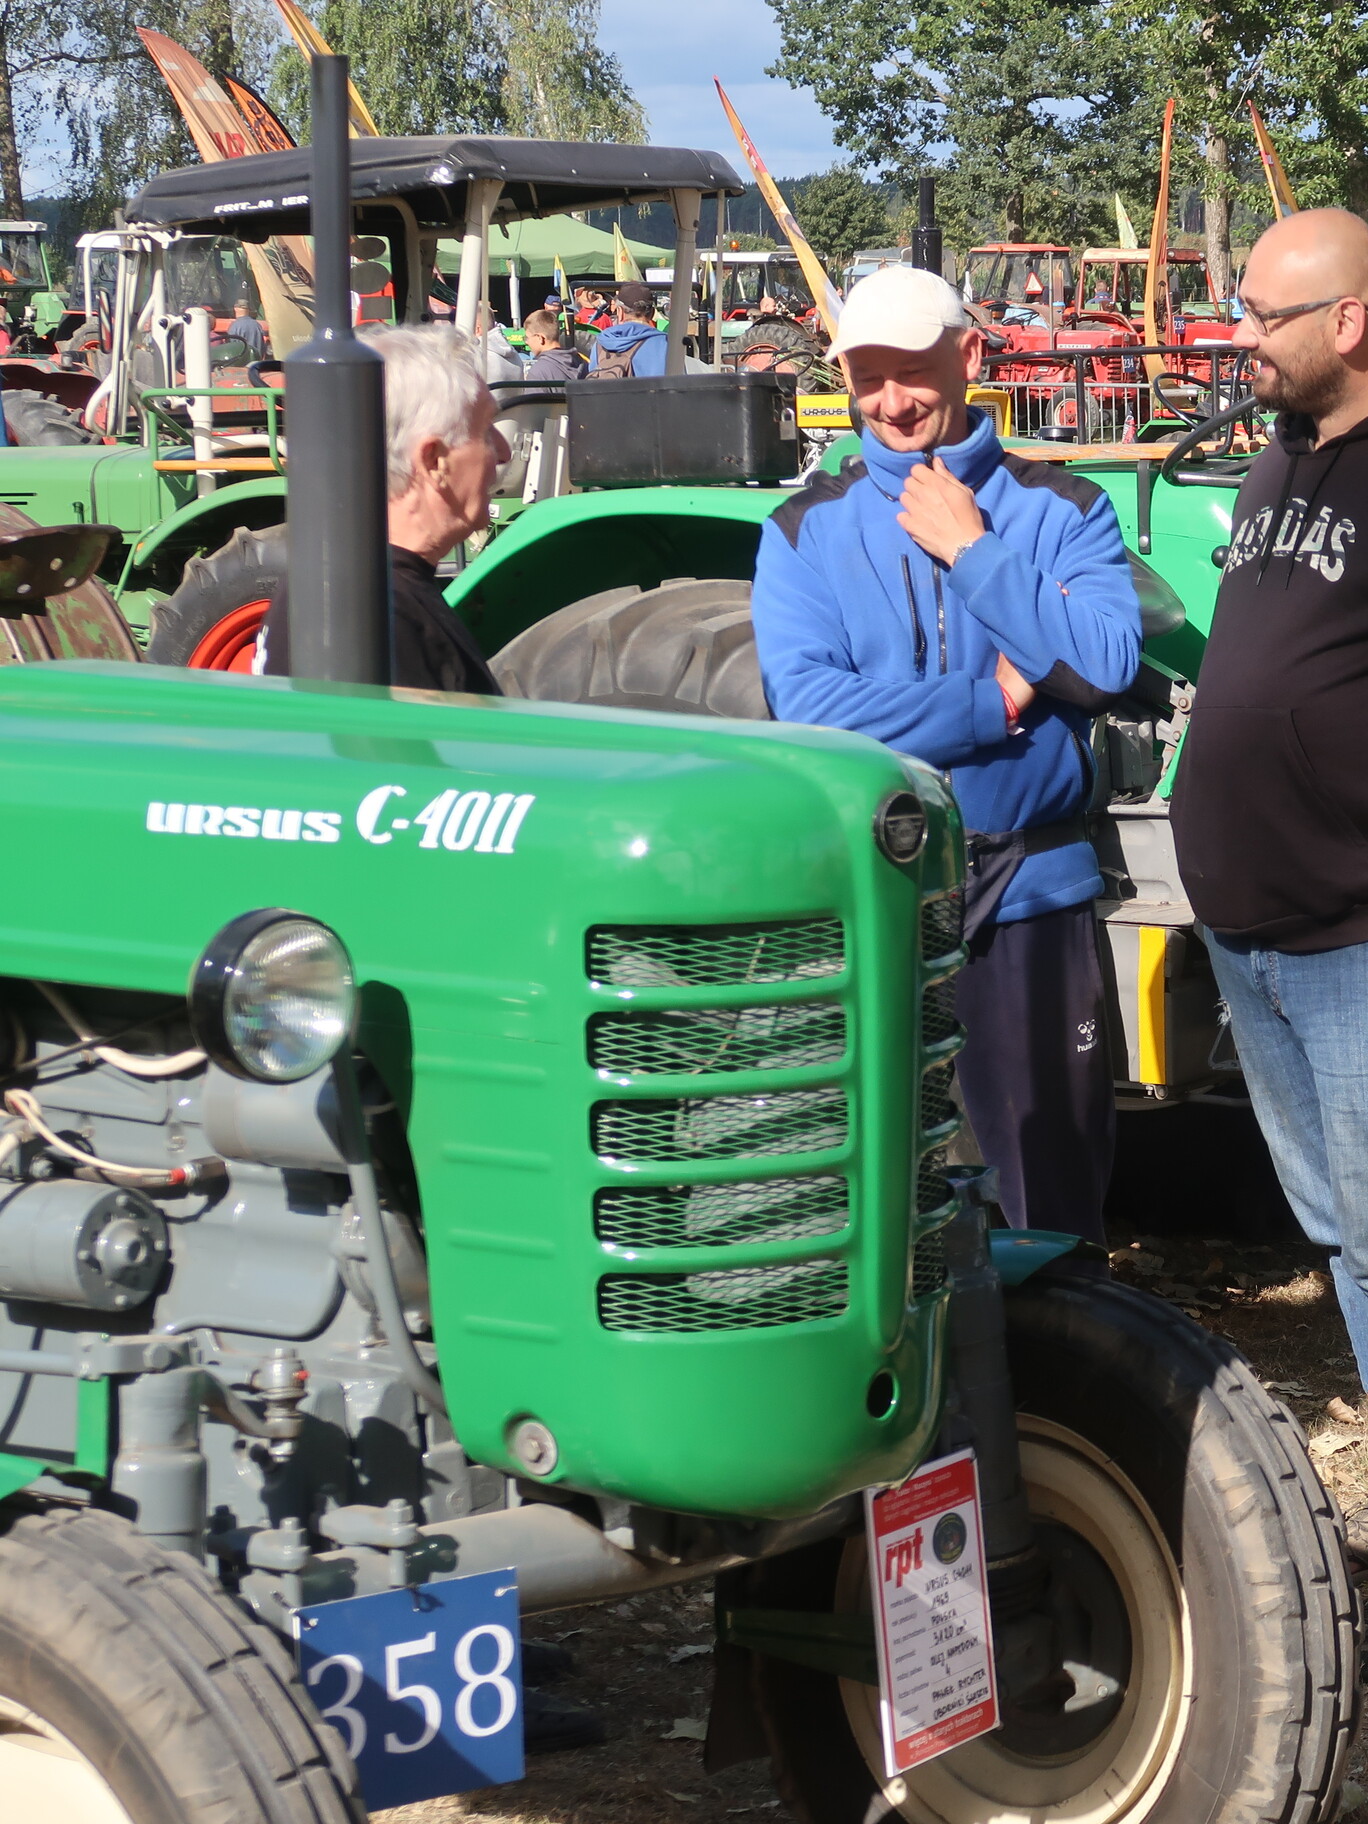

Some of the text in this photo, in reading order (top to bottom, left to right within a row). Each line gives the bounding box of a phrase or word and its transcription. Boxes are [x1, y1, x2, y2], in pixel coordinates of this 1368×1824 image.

[1174, 320, 1185, 330] 235
[1123, 358, 1134, 369] 234
[803, 407, 845, 416] URSUS
[146, 783, 536, 854] URSUS C-4011
[885, 1527, 924, 1588] rpt
[307, 1623, 518, 1760] 358
